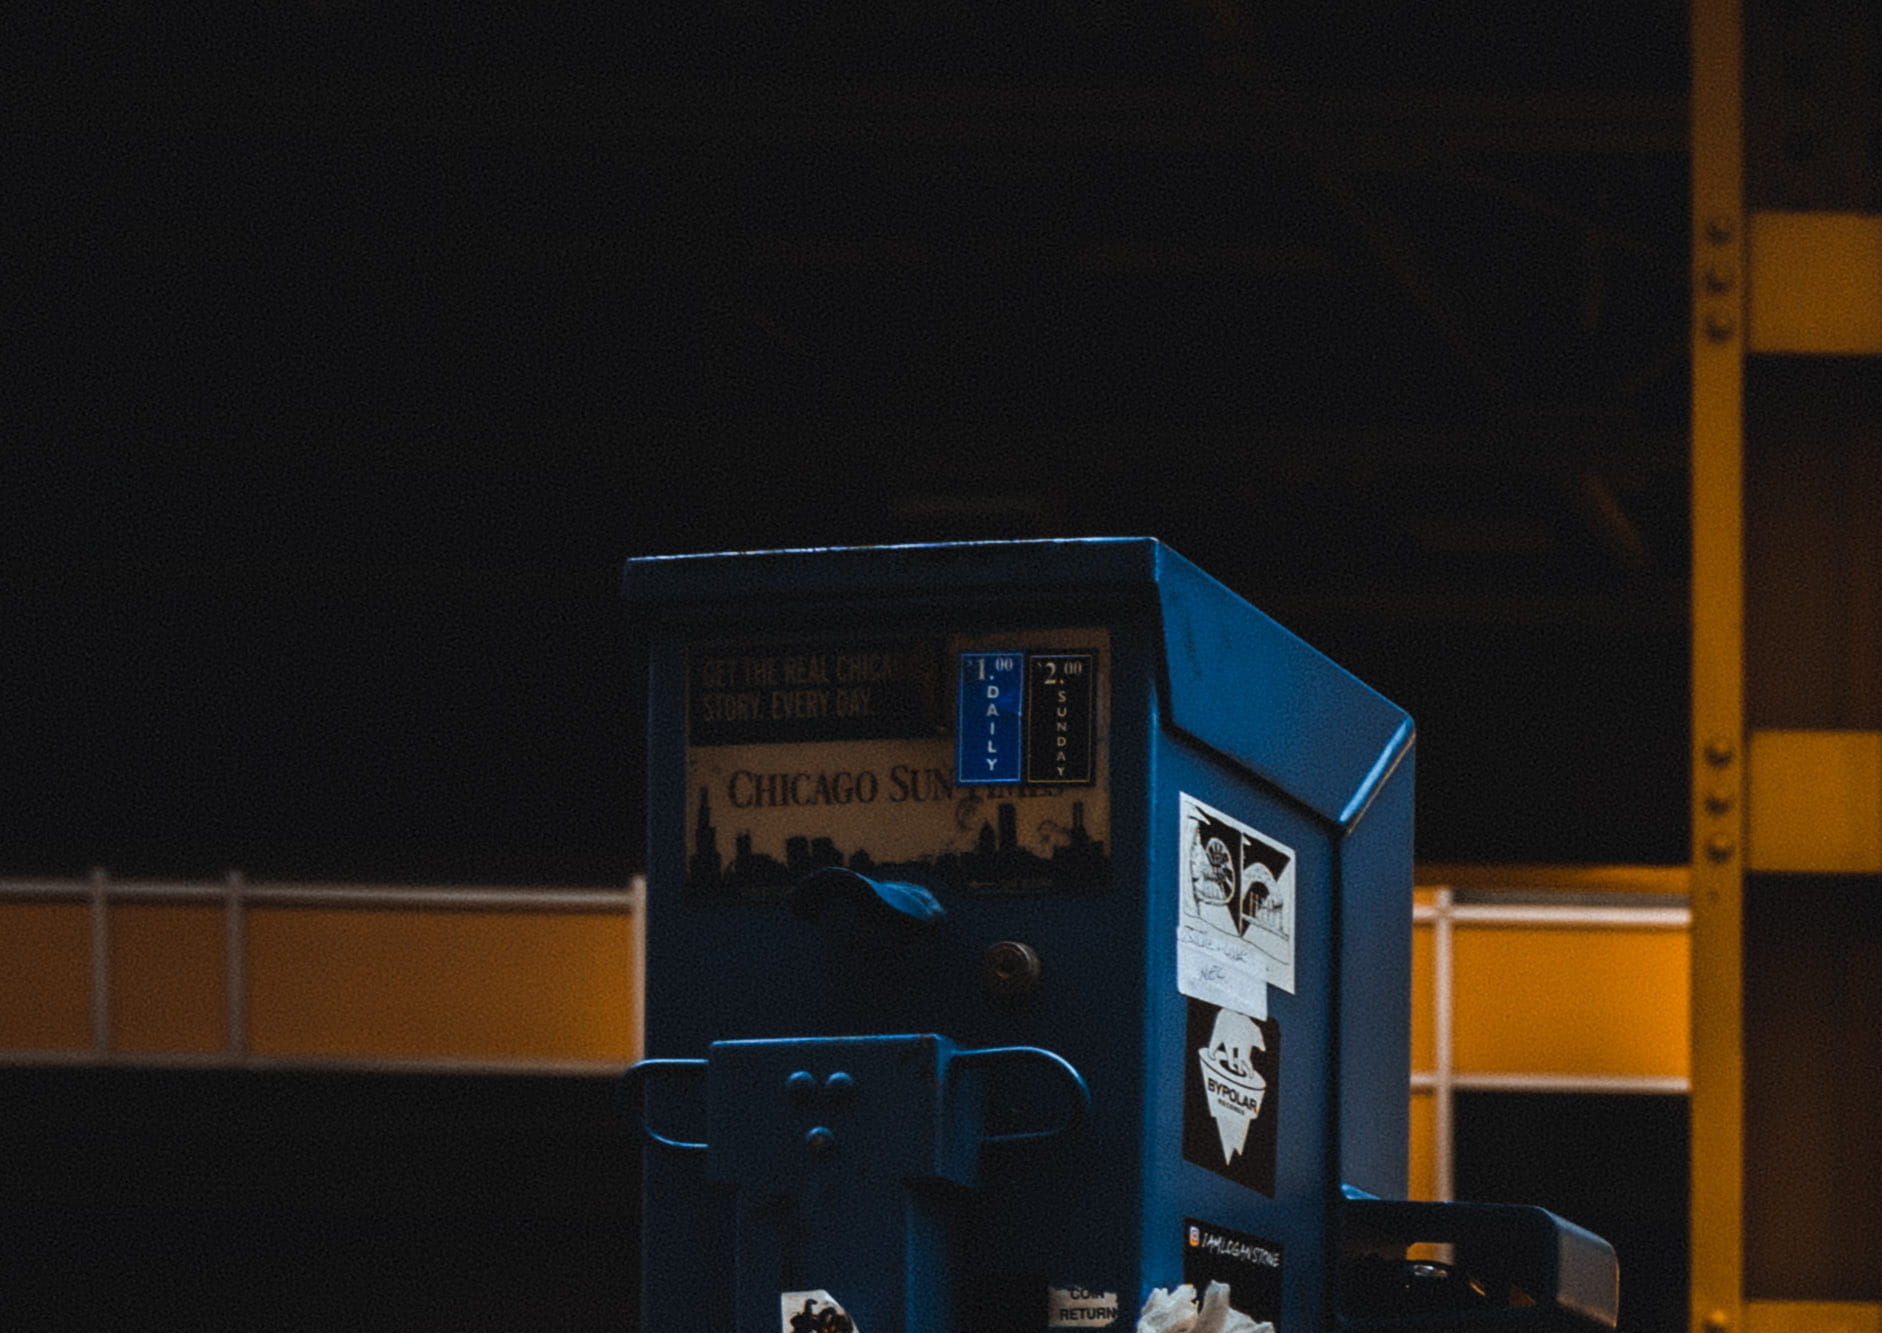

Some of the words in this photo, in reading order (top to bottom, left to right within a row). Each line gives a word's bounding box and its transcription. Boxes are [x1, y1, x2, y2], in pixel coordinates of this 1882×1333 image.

[986, 684, 999, 772] DAILY
[1055, 689, 1068, 777] SUNDAY
[728, 769, 879, 809] CHICAGO
[1208, 1078, 1257, 1111] BYPOLAR
[1059, 1307, 1117, 1321] RETURN
